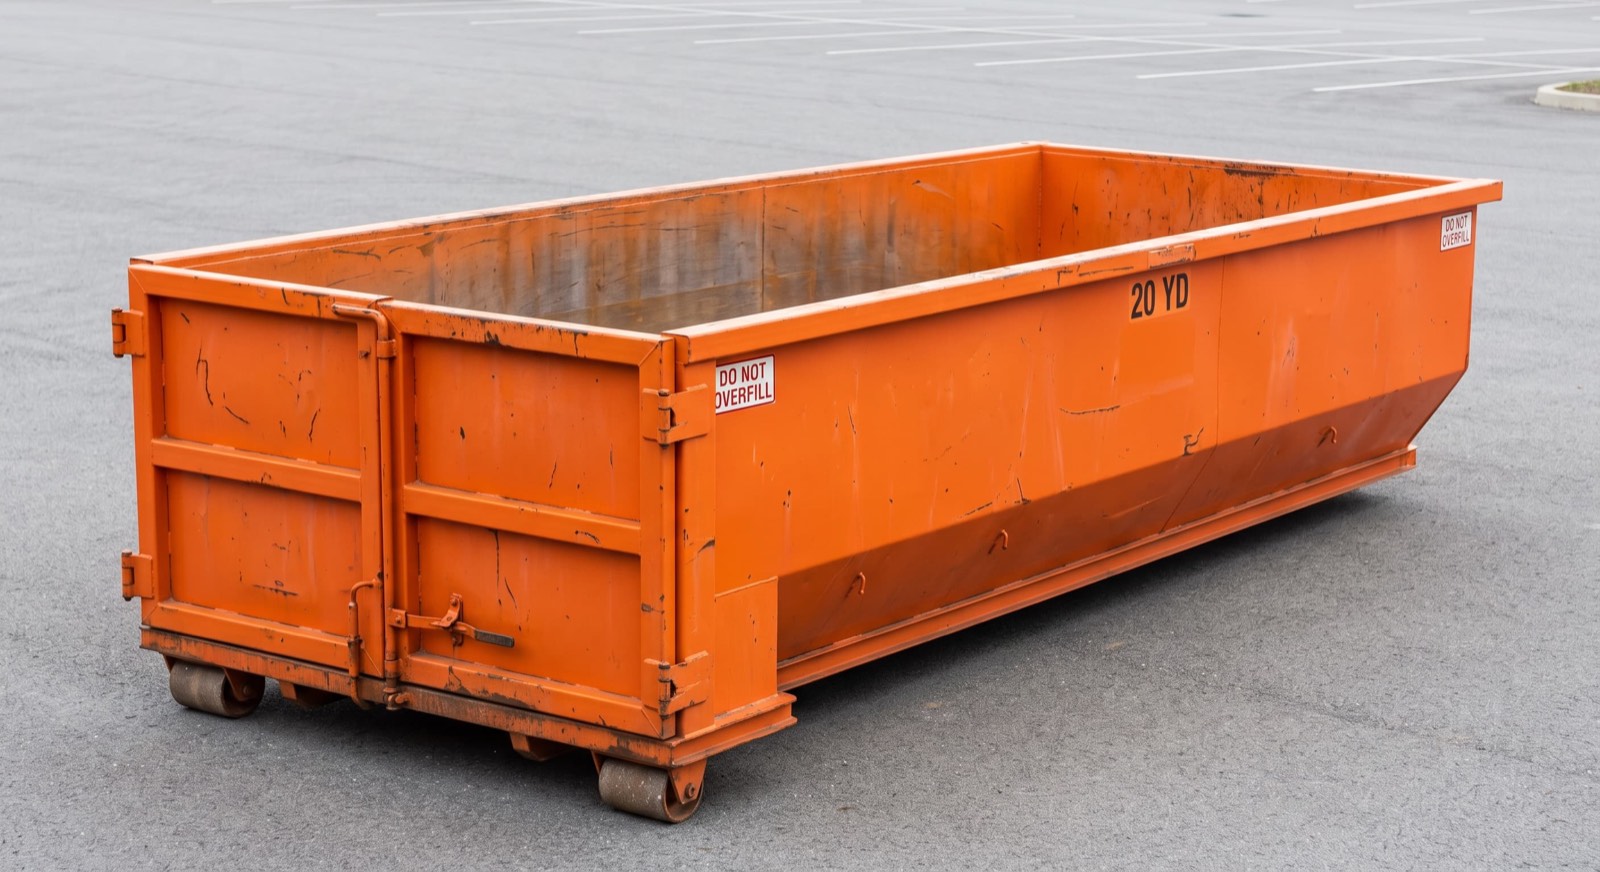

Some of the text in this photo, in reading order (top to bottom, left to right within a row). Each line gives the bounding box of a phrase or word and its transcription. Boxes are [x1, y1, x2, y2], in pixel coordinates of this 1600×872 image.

[1445, 215, 1468, 232] DO NOT
[1442, 230, 1469, 247] OVERFILL
[1131, 272, 1189, 319] 20 YD
[720, 362, 767, 387] DO NOT
[715, 381, 772, 409] OVERFILL
